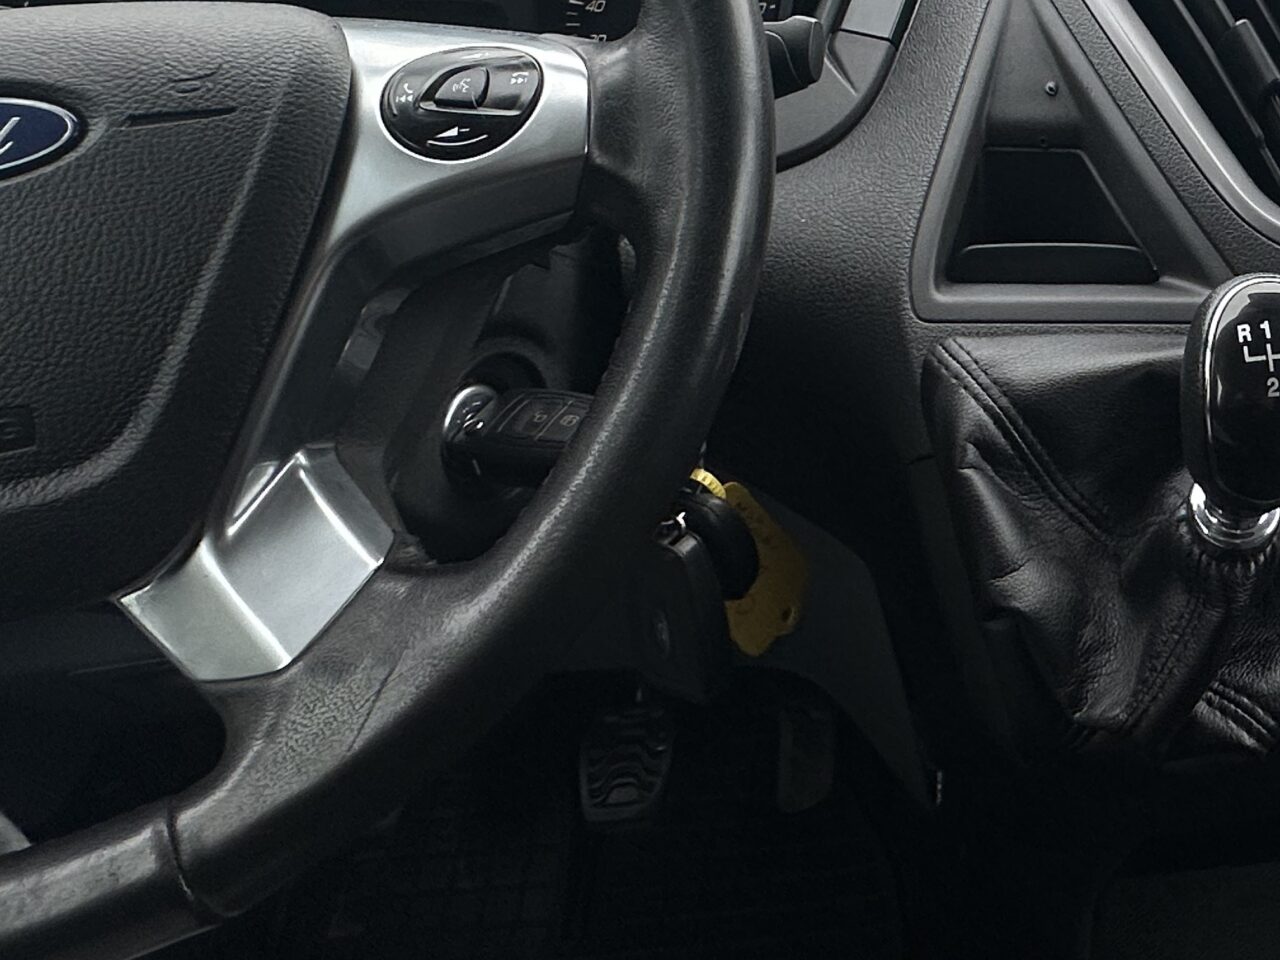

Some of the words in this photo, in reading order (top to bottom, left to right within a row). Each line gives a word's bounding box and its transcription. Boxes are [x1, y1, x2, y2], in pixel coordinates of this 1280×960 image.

[584, 0, 606, 13] 40
[1237, 324, 1252, 343] R
[1259, 320, 1271, 339] 1
[1266, 378, 1280, 397] 2
